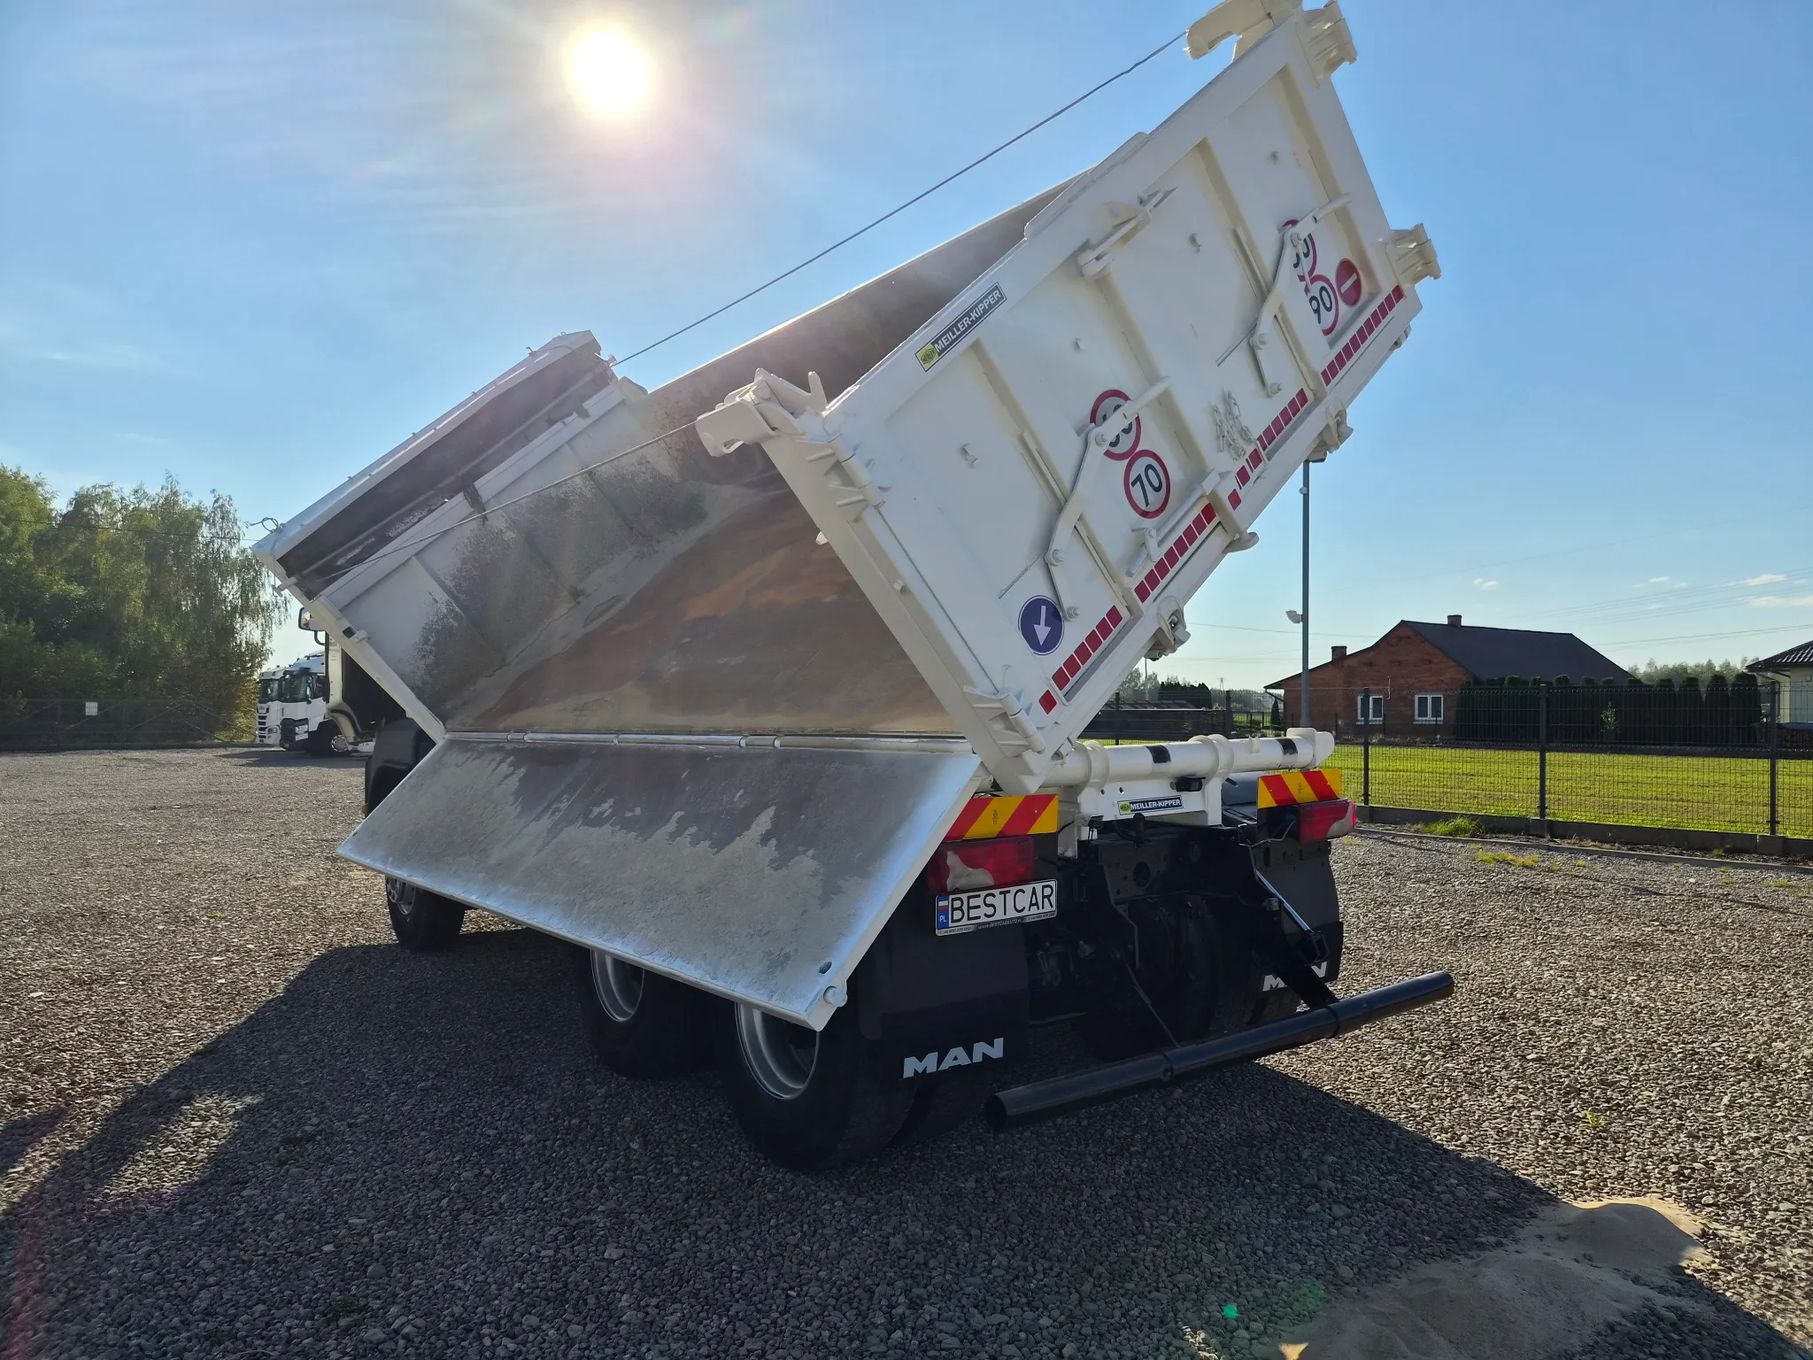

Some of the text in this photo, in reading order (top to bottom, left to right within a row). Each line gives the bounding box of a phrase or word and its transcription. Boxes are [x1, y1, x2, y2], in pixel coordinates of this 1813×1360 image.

[934, 289, 1002, 353] MEILLER-KIPPER
[1308, 285, 1333, 324] 90
[1130, 463, 1163, 508] 70
[1130, 799, 1182, 811] MEILLER-KIPPER
[939, 914, 947, 922] PL
[950, 884, 1055, 924] BESTCAR
[1262, 961, 1328, 992] MN
[903, 1037, 1004, 1079] MAN
